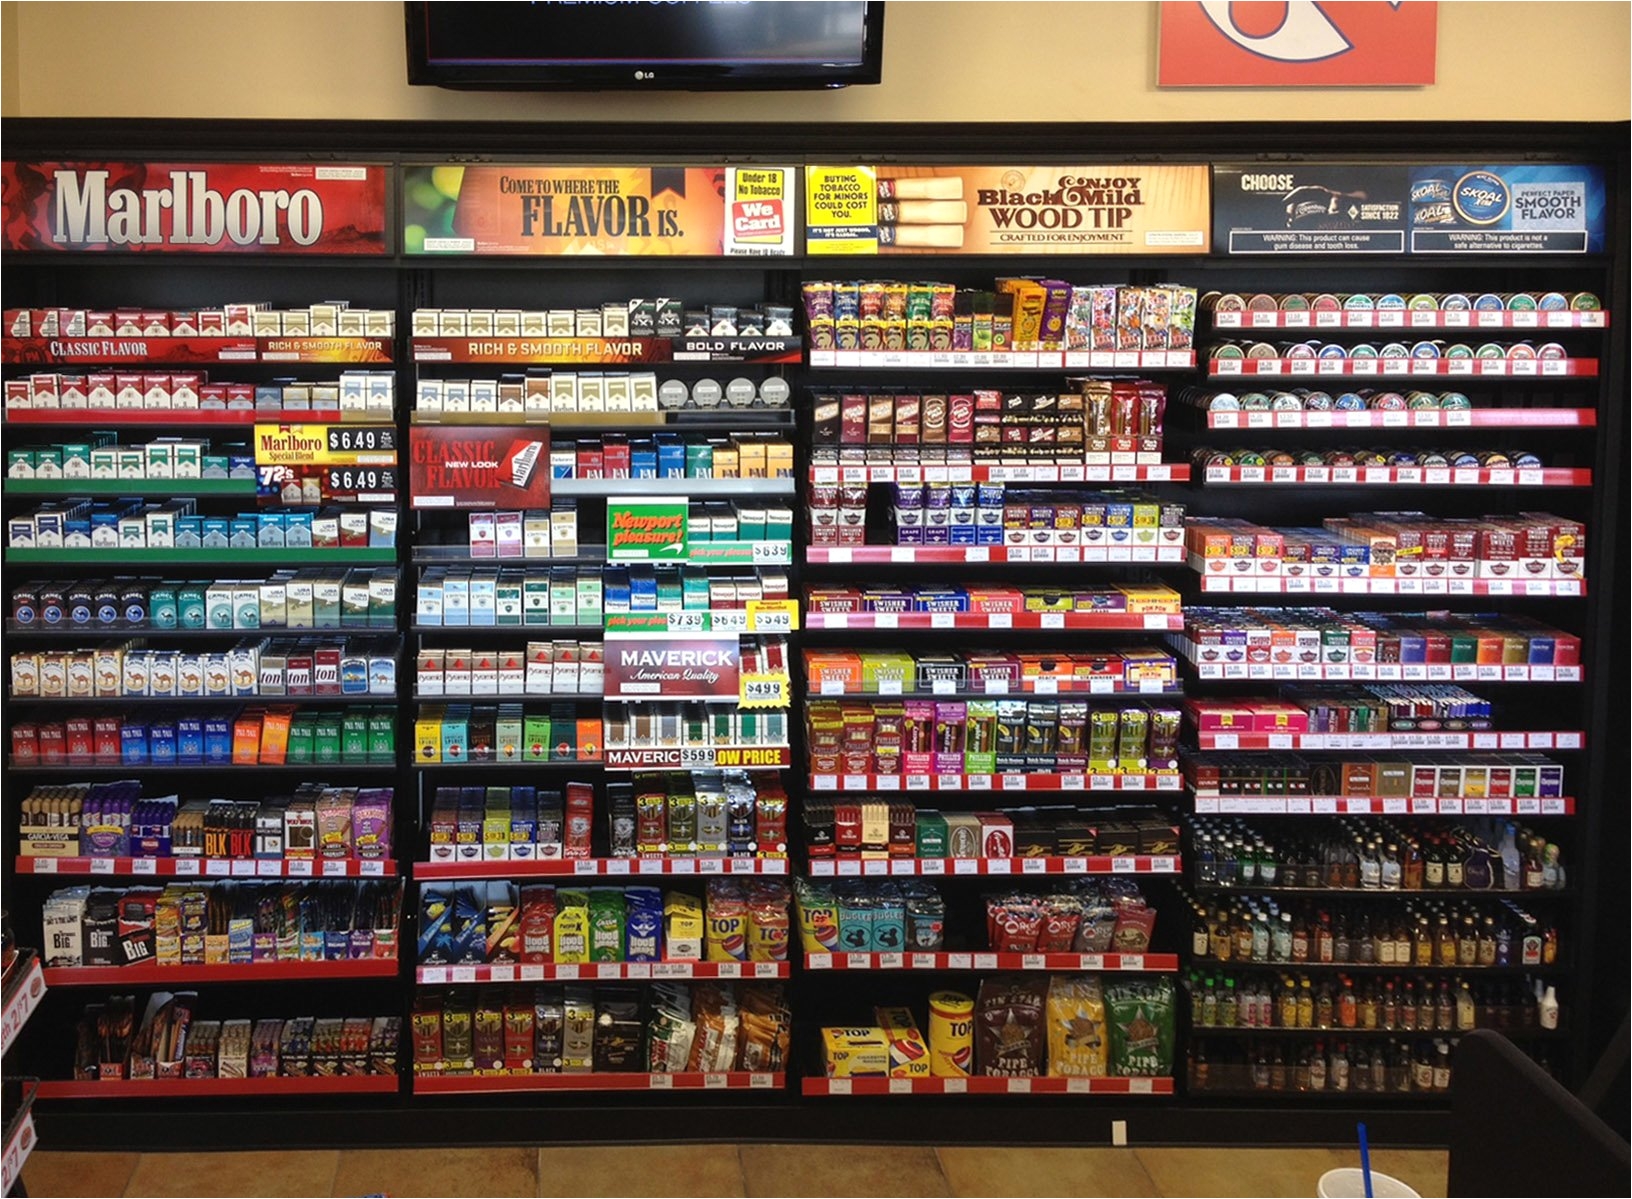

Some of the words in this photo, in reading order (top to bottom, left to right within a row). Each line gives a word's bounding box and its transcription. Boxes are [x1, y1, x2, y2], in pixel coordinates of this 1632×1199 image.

[500, 176, 535, 194] COME
[537, 180, 551, 194] TO
[552, 180, 593, 194] WHERE
[595, 180, 620, 194] THE
[742, 173, 766, 182] Under
[768, 173, 777, 184] 18
[824, 175, 857, 183] BUYING
[1241, 174, 1295, 191] CHOOSE
[738, 184, 749, 195] No
[750, 185, 781, 195] Tobacco
[820, 184, 861, 192] TOBACCO
[1411, 184, 1441, 202] SKOAL
[1460, 187, 1502, 203] SKOAL
[1521, 190, 1551, 198] PERFECT
[814, 193, 831, 201] FOR
[833, 192, 868, 200] MINORS
[1515, 196, 1582, 210] SMOOTH
[53, 171, 324, 245] Marlboro
[741, 203, 774, 217] We
[846, 201, 867, 209] COST
[1361, 204, 1399, 212] SATISFACTION
[520, 195, 651, 237] FLAVOR
[657, 209, 685, 238] IS.
[832, 210, 852, 218] YOU.
[990, 207, 1083, 229] WOOD
[1088, 207, 1133, 229] TIP
[1361, 212, 1381, 220] SINCE
[1382, 211, 1399, 220] 1822
[1521, 208, 1576, 220] FLAVOR
[735, 214, 781, 231] Card
[999, 233, 1046, 242] CRAFTED
[1046, 233, 1067, 242] FOR
[1067, 233, 1125, 243] ENJOYMENT
[1263, 234, 1298, 242] WARNING:
[1313, 235, 1337, 243] product
[1499, 235, 1524, 243] product
[1289, 242, 1313, 250] disease
[1511, 242, 1544, 250] cigarettes.
[51, 340, 101, 356] CLASSIC
[102, 340, 148, 356] FLAVOR
[268, 341, 287, 351] RICH
[290, 341, 299, 351] &
[302, 341, 342, 351] SMOOTH
[345, 341, 382, 351] FLAVOR
[468, 342, 503, 356] RICH
[507, 342, 517, 356] &
[520, 342, 582, 356] SMOOTH
[586, 342, 643, 356] FLAVOR
[686, 341, 725, 351] BOLD
[730, 341, 785, 351] FLAVOR
[261, 435, 322, 451] Marlboro
[329, 431, 375, 449] $6.49
[269, 452, 295, 462] Special
[295, 452, 314, 461] Blend
[413, 440, 495, 463] CLASSIC
[259, 466, 294, 486] 72's
[330, 471, 377, 489] $6.49
[426, 465, 501, 489] FLAVOR
[612, 511, 683, 530] Newport
[614, 530, 683, 547] pleasure!
[621, 650, 733, 666] MAVERICK
[630, 667, 680, 681] American
[681, 668, 720, 684] Quality
[608, 751, 681, 764] MAVERIC
[682, 749, 715, 761] $599
[743, 749, 781, 764] PRICE
[205, 833, 227, 856] BLK
[230, 832, 252, 855] BLK
[709, 918, 739, 933] TOP
[53, 933, 71, 949] BIG
[90, 931, 108, 947] BIG
[122, 940, 149, 961] BIG
[844, 1029, 870, 1037] TOP
[833, 1052, 849, 1060] TOP
[998, 1057, 1028, 1068] PIPE
[909, 1063, 928, 1073] TOP
